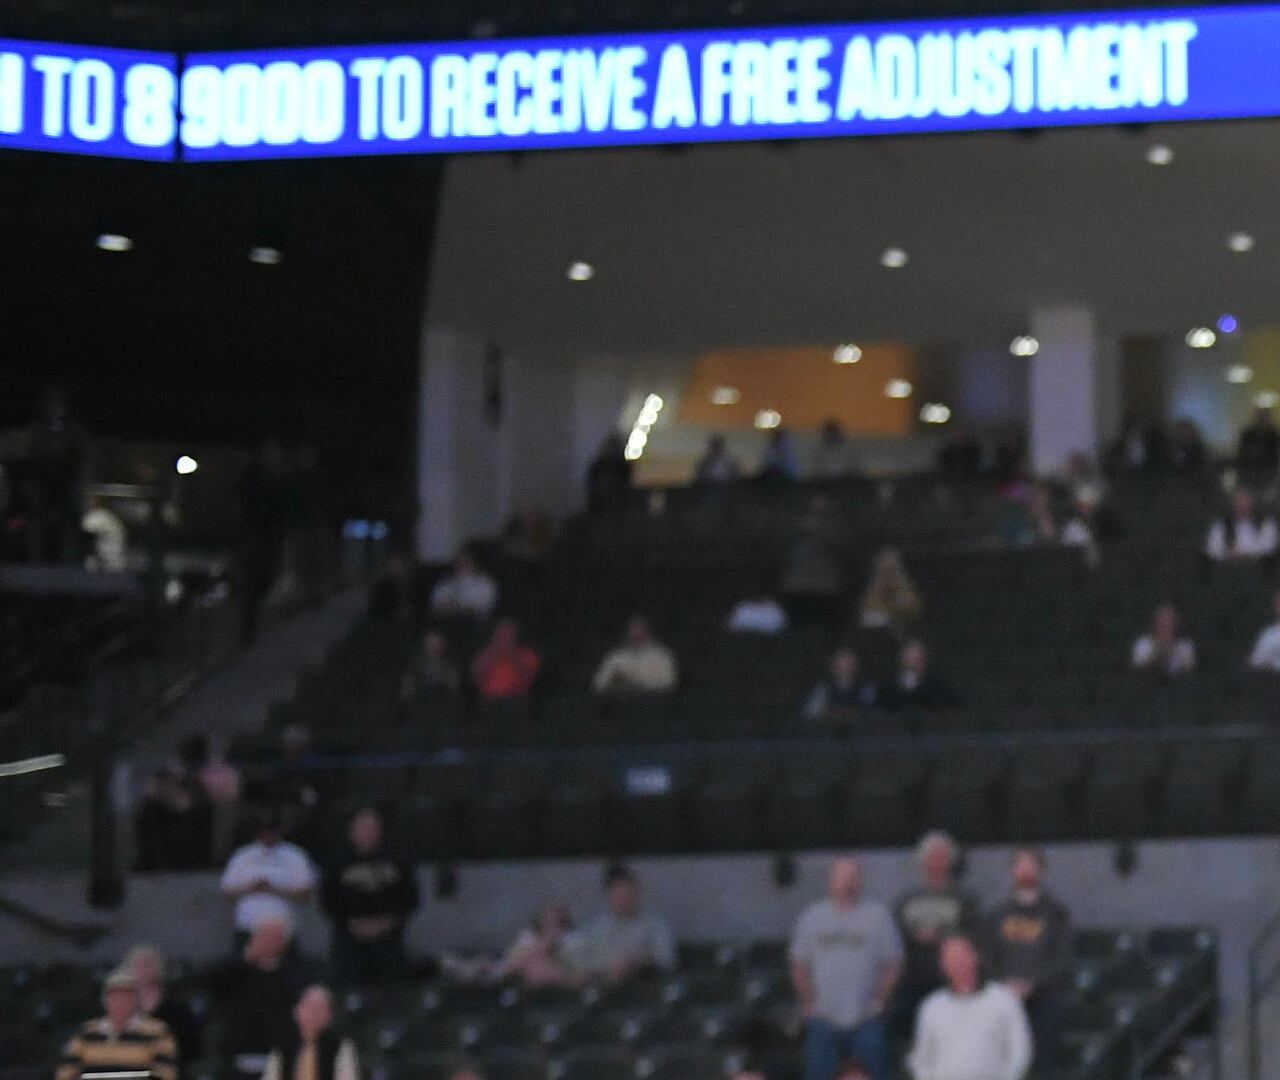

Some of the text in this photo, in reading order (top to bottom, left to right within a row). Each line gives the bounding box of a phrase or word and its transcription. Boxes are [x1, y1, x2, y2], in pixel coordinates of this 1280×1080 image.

[32, 55, 115, 141] TO
[350, 56, 423, 140] TO
[430, 47, 647, 138] RECEIVE
[652, 43, 697, 129] A
[702, 37, 832, 127] FREE
[836, 21, 1197, 121] ADJUSTMENT
